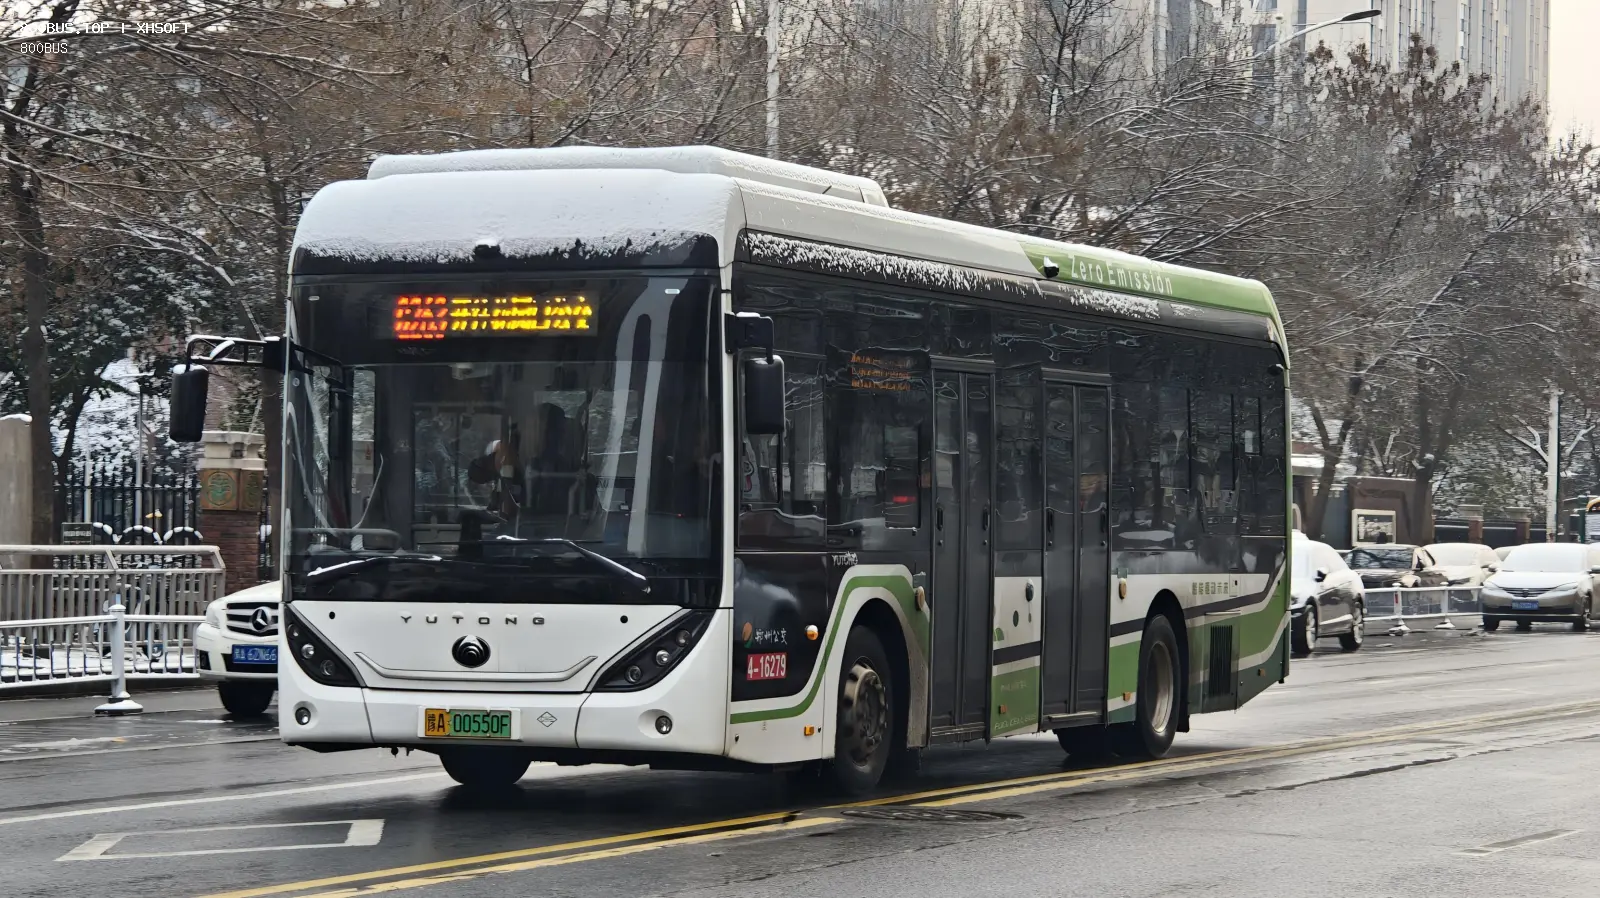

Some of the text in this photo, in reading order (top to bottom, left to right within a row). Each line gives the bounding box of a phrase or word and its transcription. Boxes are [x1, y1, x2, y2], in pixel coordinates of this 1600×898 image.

[1067, 254, 1173, 295] Zero Emission
[400, 615, 546, 626] YUTONG
[747, 654, 787, 679] 4-16279
